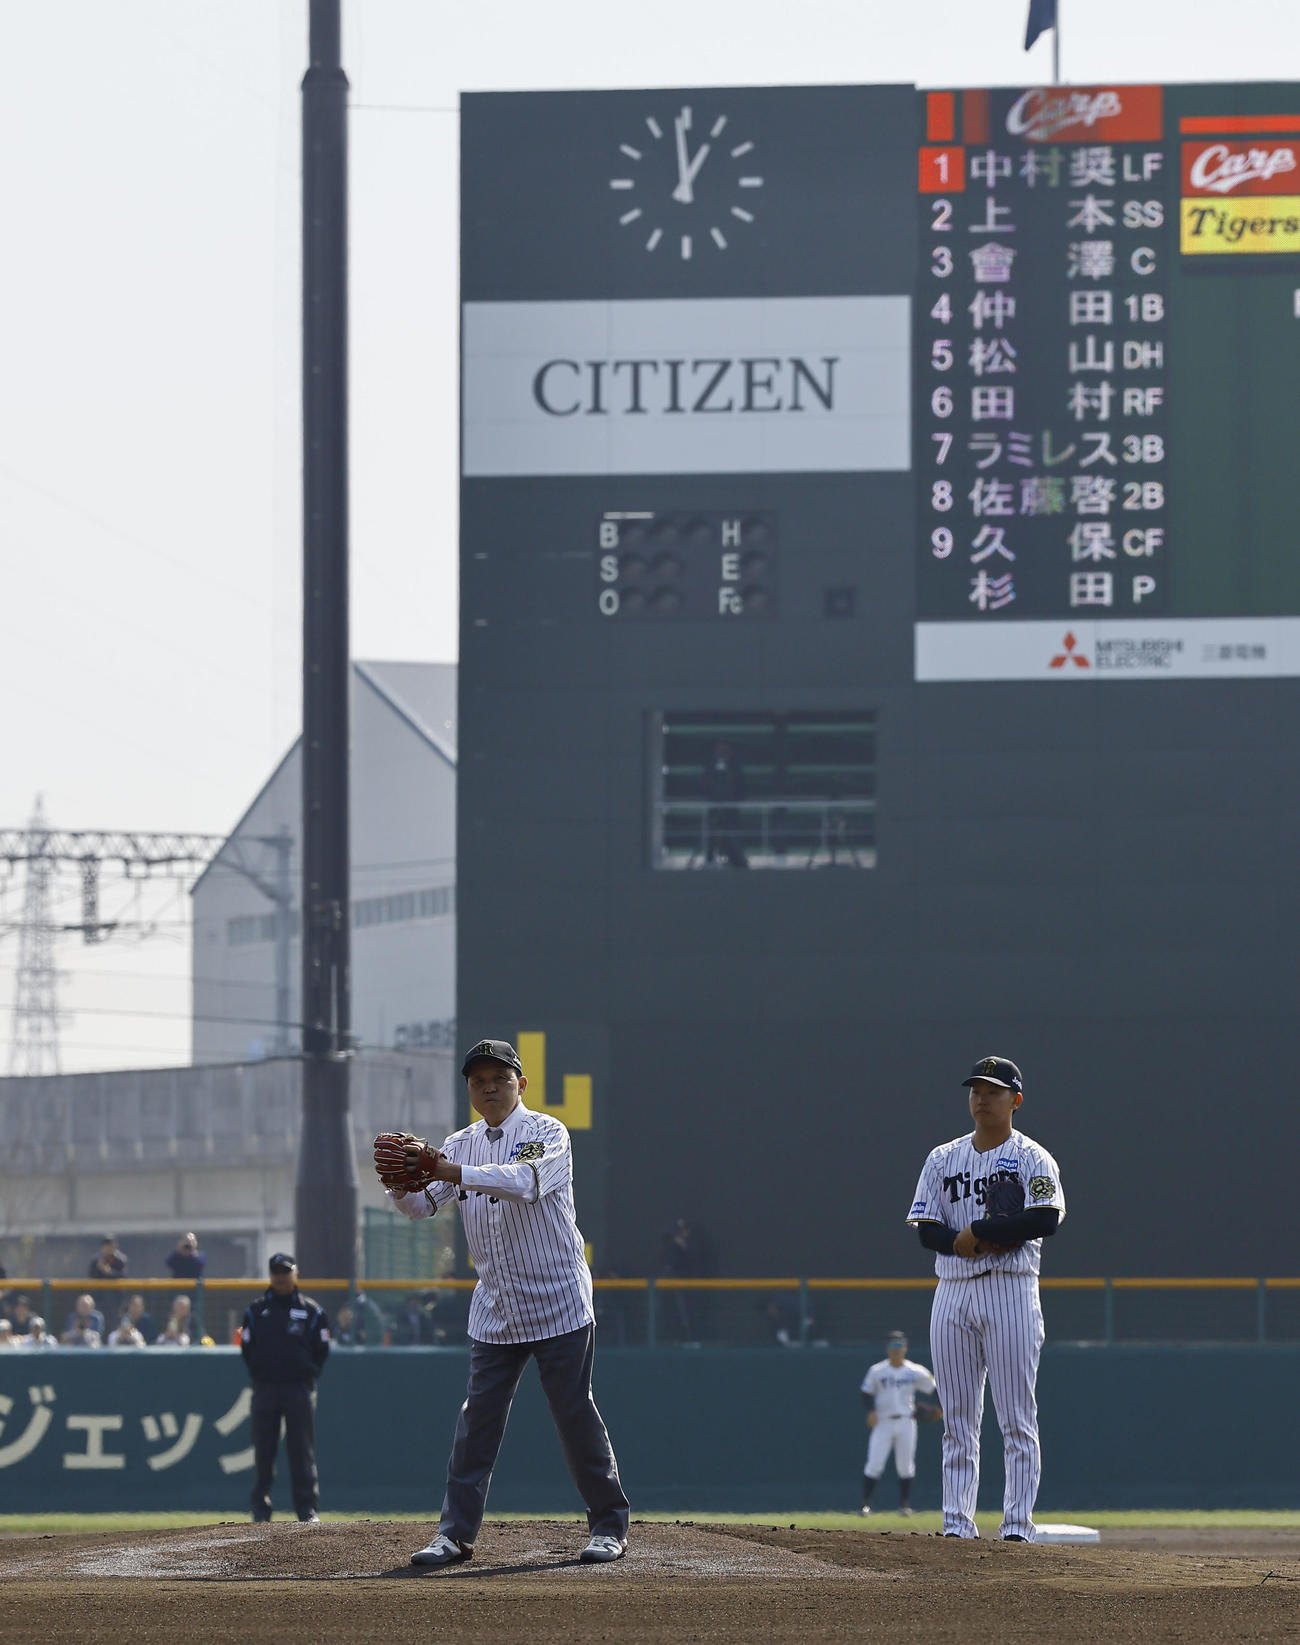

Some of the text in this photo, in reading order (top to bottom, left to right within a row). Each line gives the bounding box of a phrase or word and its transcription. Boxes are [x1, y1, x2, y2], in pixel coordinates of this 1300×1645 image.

[1006, 88, 1122, 139] Carp
[933, 153, 949, 184] 1
[1123, 153, 1163, 182] LF
[1190, 144, 1297, 193] Carp
[931, 199, 953, 231] 2
[1122, 200, 1164, 228] SS
[1189, 206, 1300, 243] Tigers
[931, 246, 953, 278] 3
[1130, 247, 1156, 275] C
[931, 293, 953, 325] 4
[1124, 293, 1164, 323] 1B
[931, 339, 953, 371] 5
[1122, 341, 1163, 369] DH
[532, 357, 840, 417] CITIZEN
[931, 386, 953, 418] 6
[1123, 387, 1164, 416] RF
[932, 430, 1165, 469] 7 ラミレス 3B
[931, 480, 953, 512] 8
[1122, 481, 1165, 510] 2B
[600, 521, 619, 548] B
[721, 520, 741, 547] H
[931, 526, 953, 558] 9
[1122, 528, 1164, 557] CF
[600, 555, 619, 583] S
[721, 554, 740, 581] E
[599, 589, 620, 615] O
[1132, 575, 1156, 604] P
